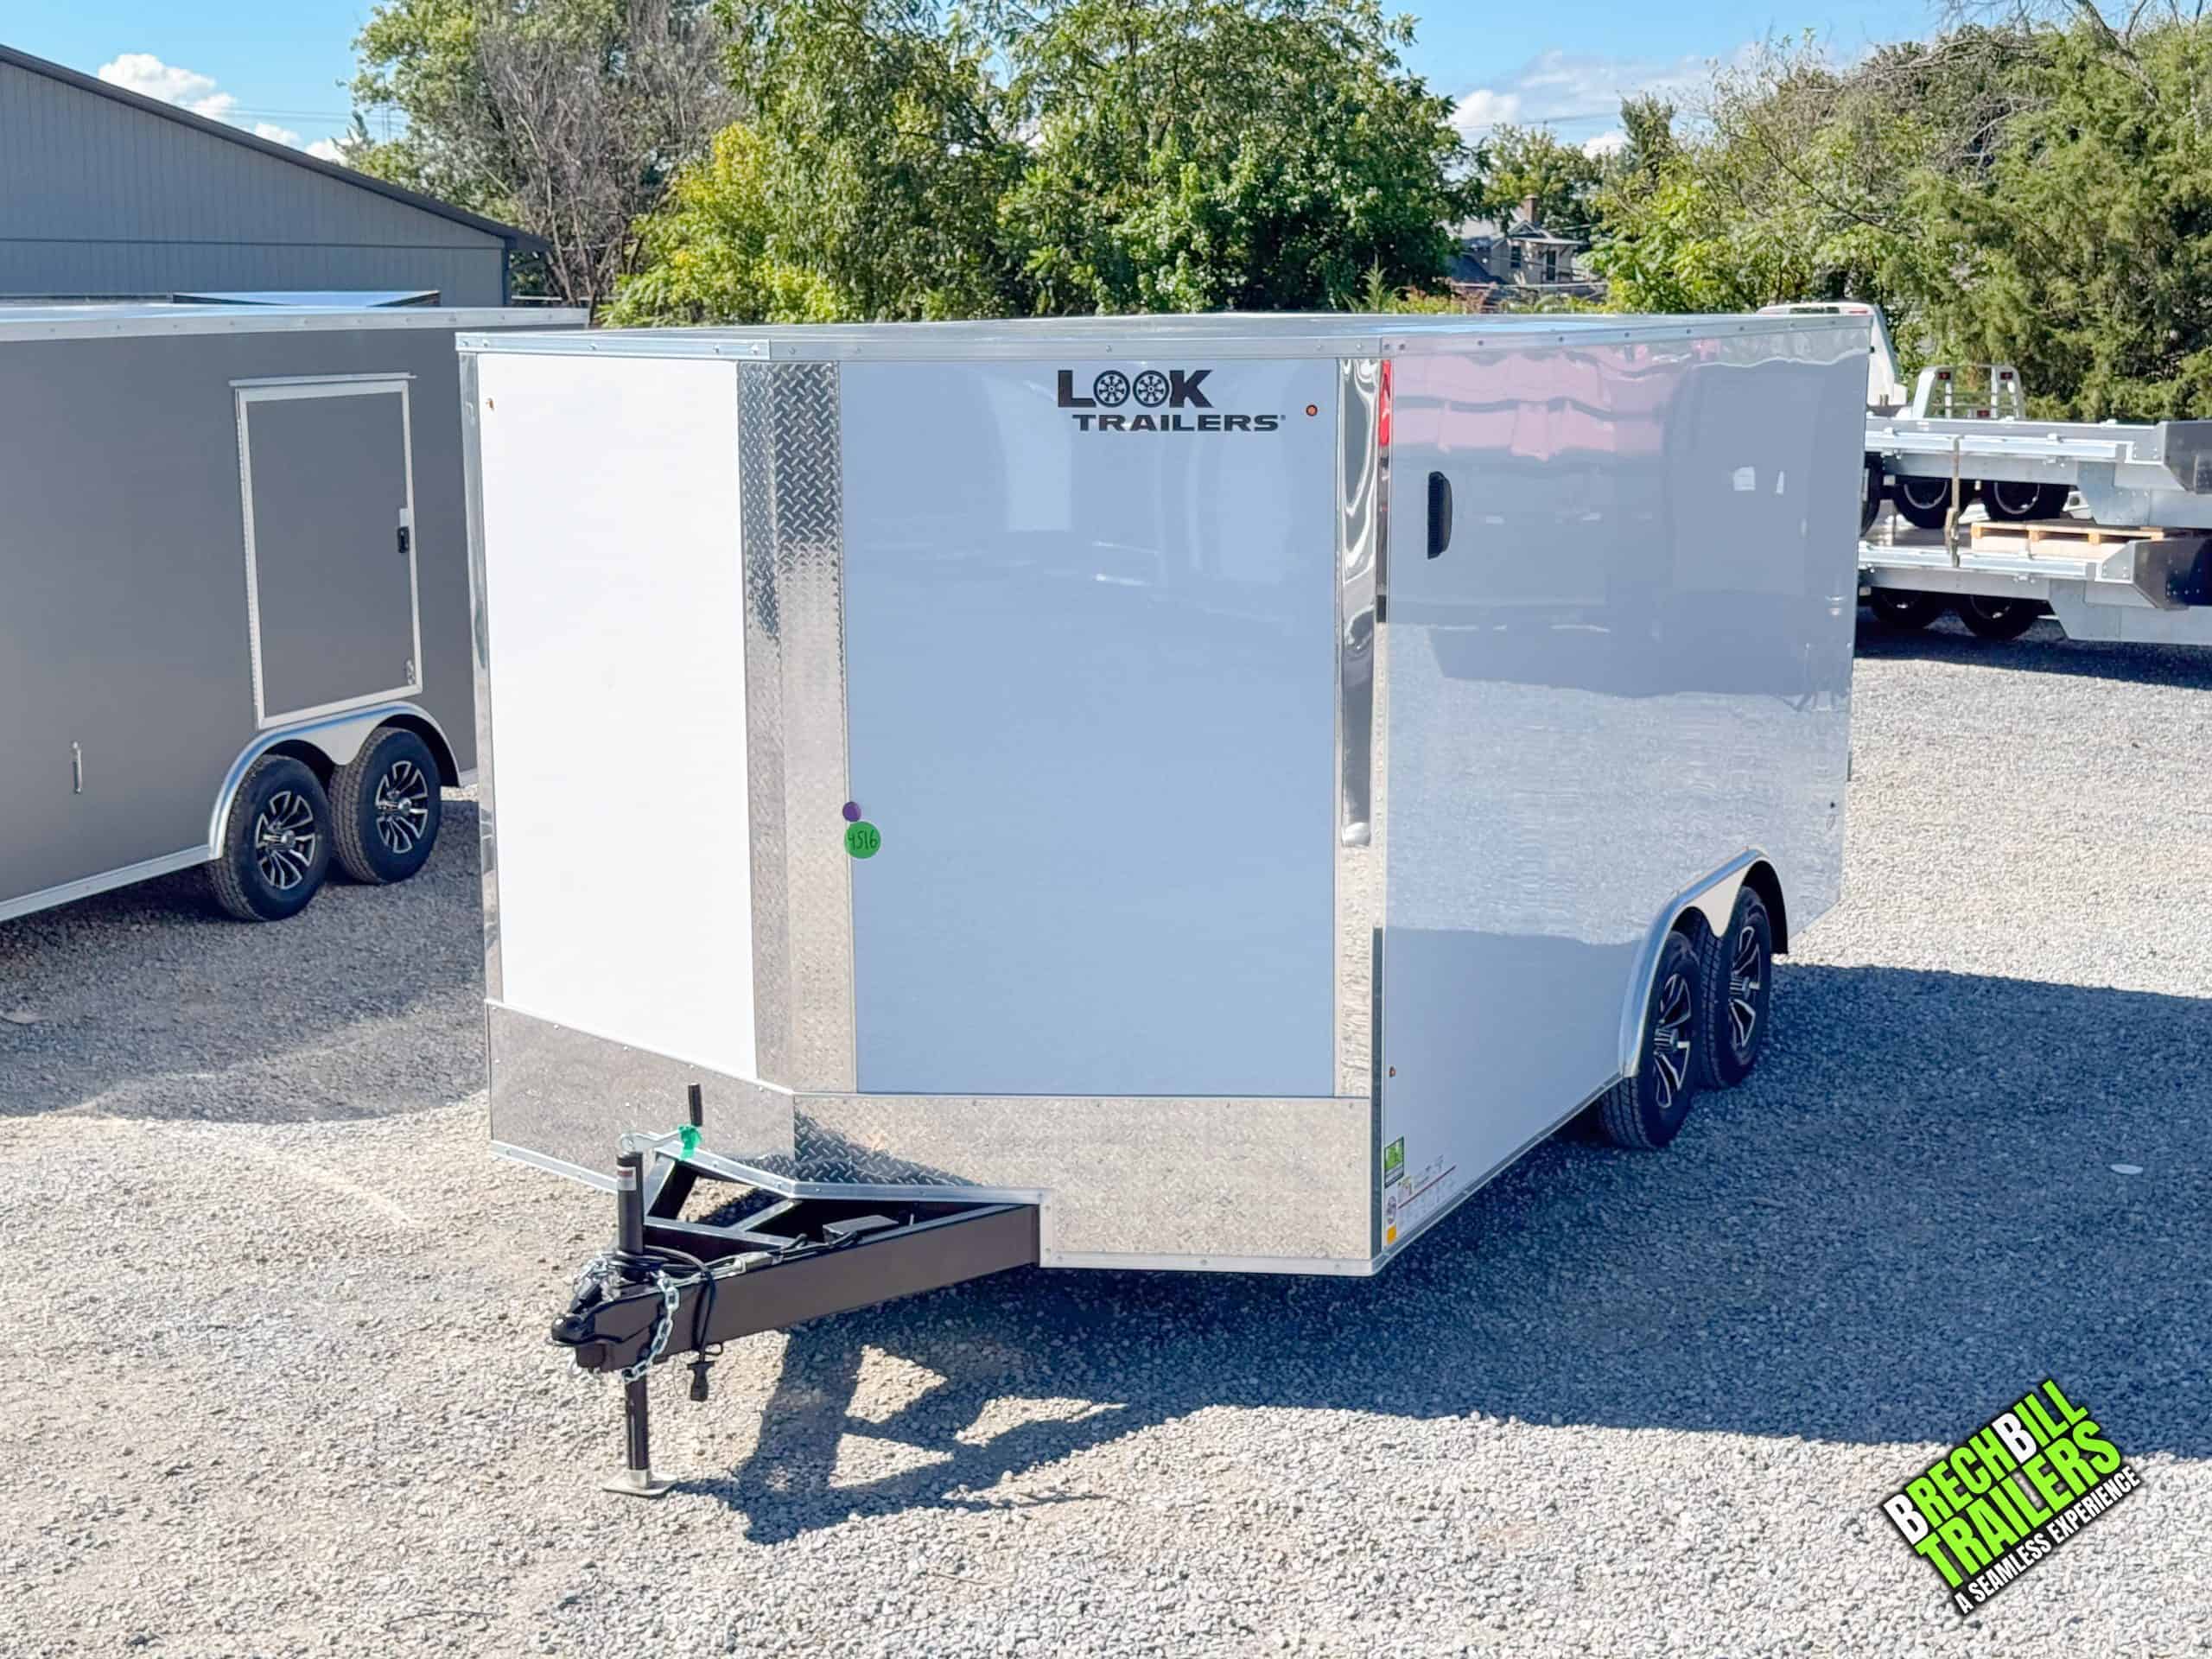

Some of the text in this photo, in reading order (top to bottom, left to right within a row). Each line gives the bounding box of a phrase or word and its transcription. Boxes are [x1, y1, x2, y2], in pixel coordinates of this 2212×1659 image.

[1058, 370, 1213, 408] LOOK
[1072, 415, 1279, 431] TRAILERS
[848, 830, 878, 850] 4516
